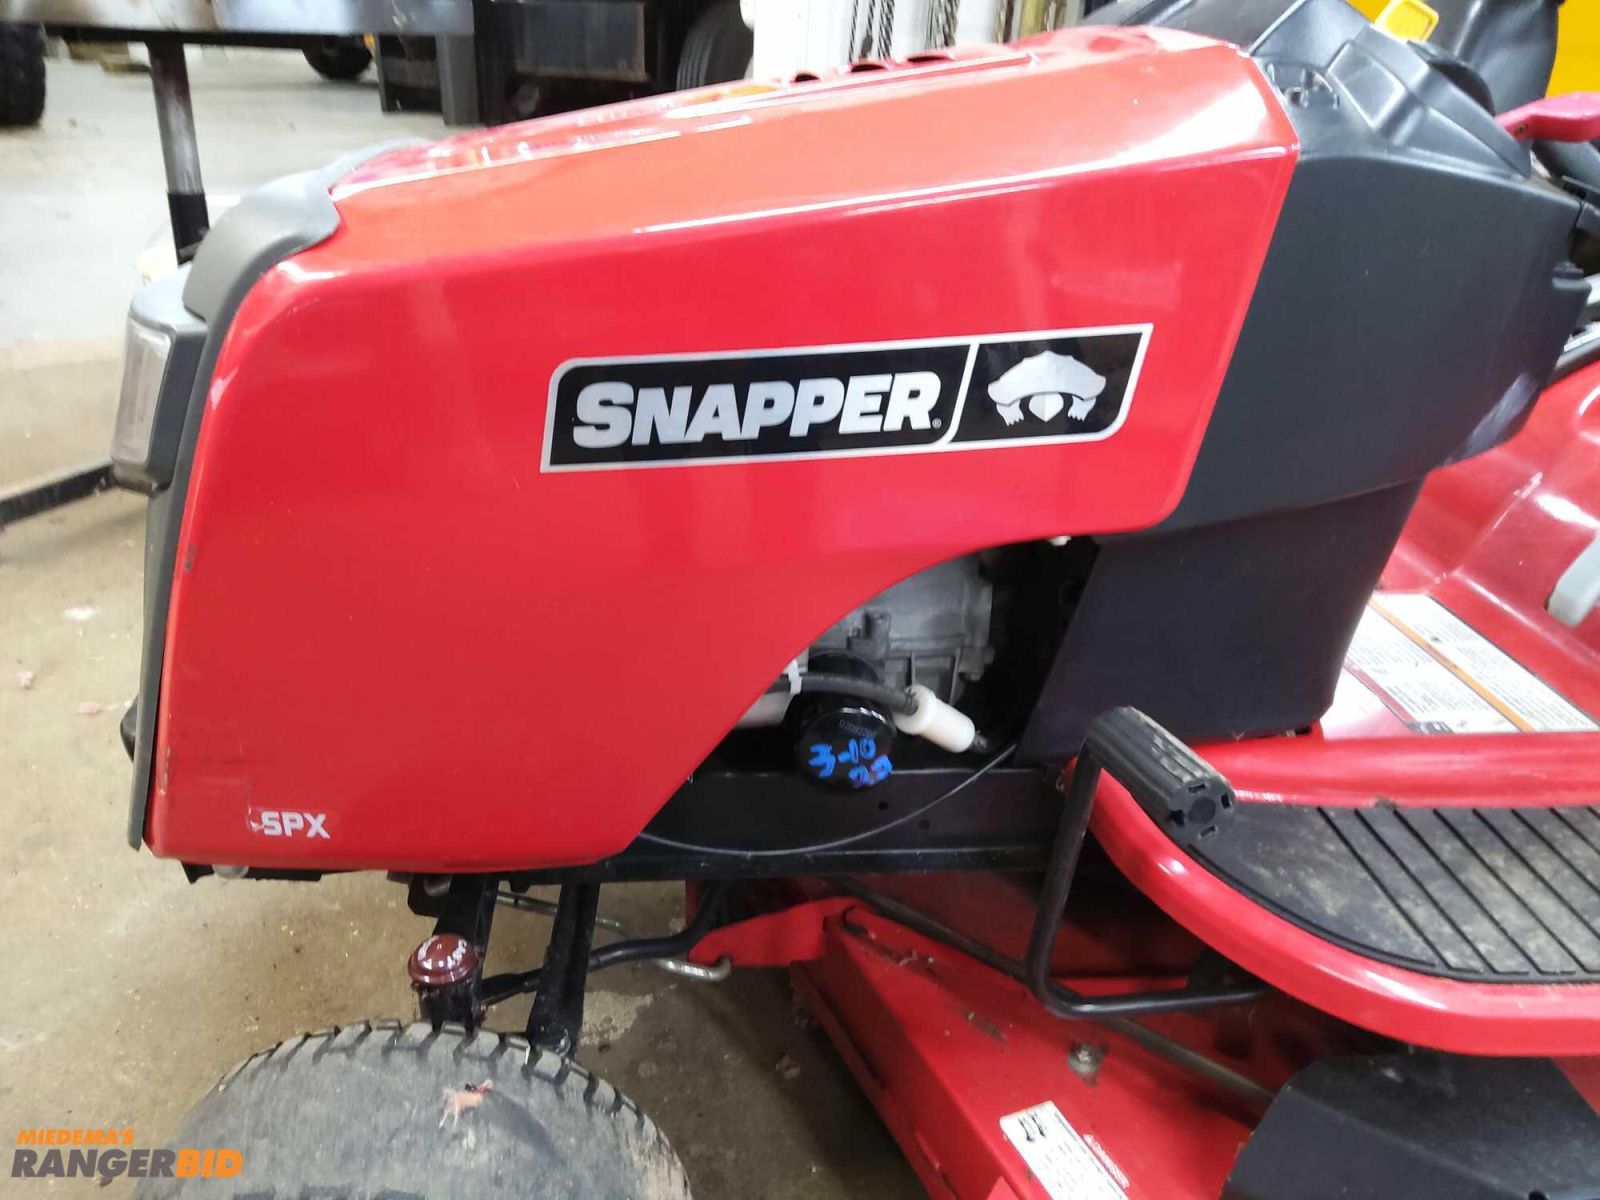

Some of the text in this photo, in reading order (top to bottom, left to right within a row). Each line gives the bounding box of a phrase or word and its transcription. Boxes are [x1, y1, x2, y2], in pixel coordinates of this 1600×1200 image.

[573, 371, 941, 448] SNAPPER
[809, 739, 876, 777] 3-10
[261, 810, 331, 839] SPX
